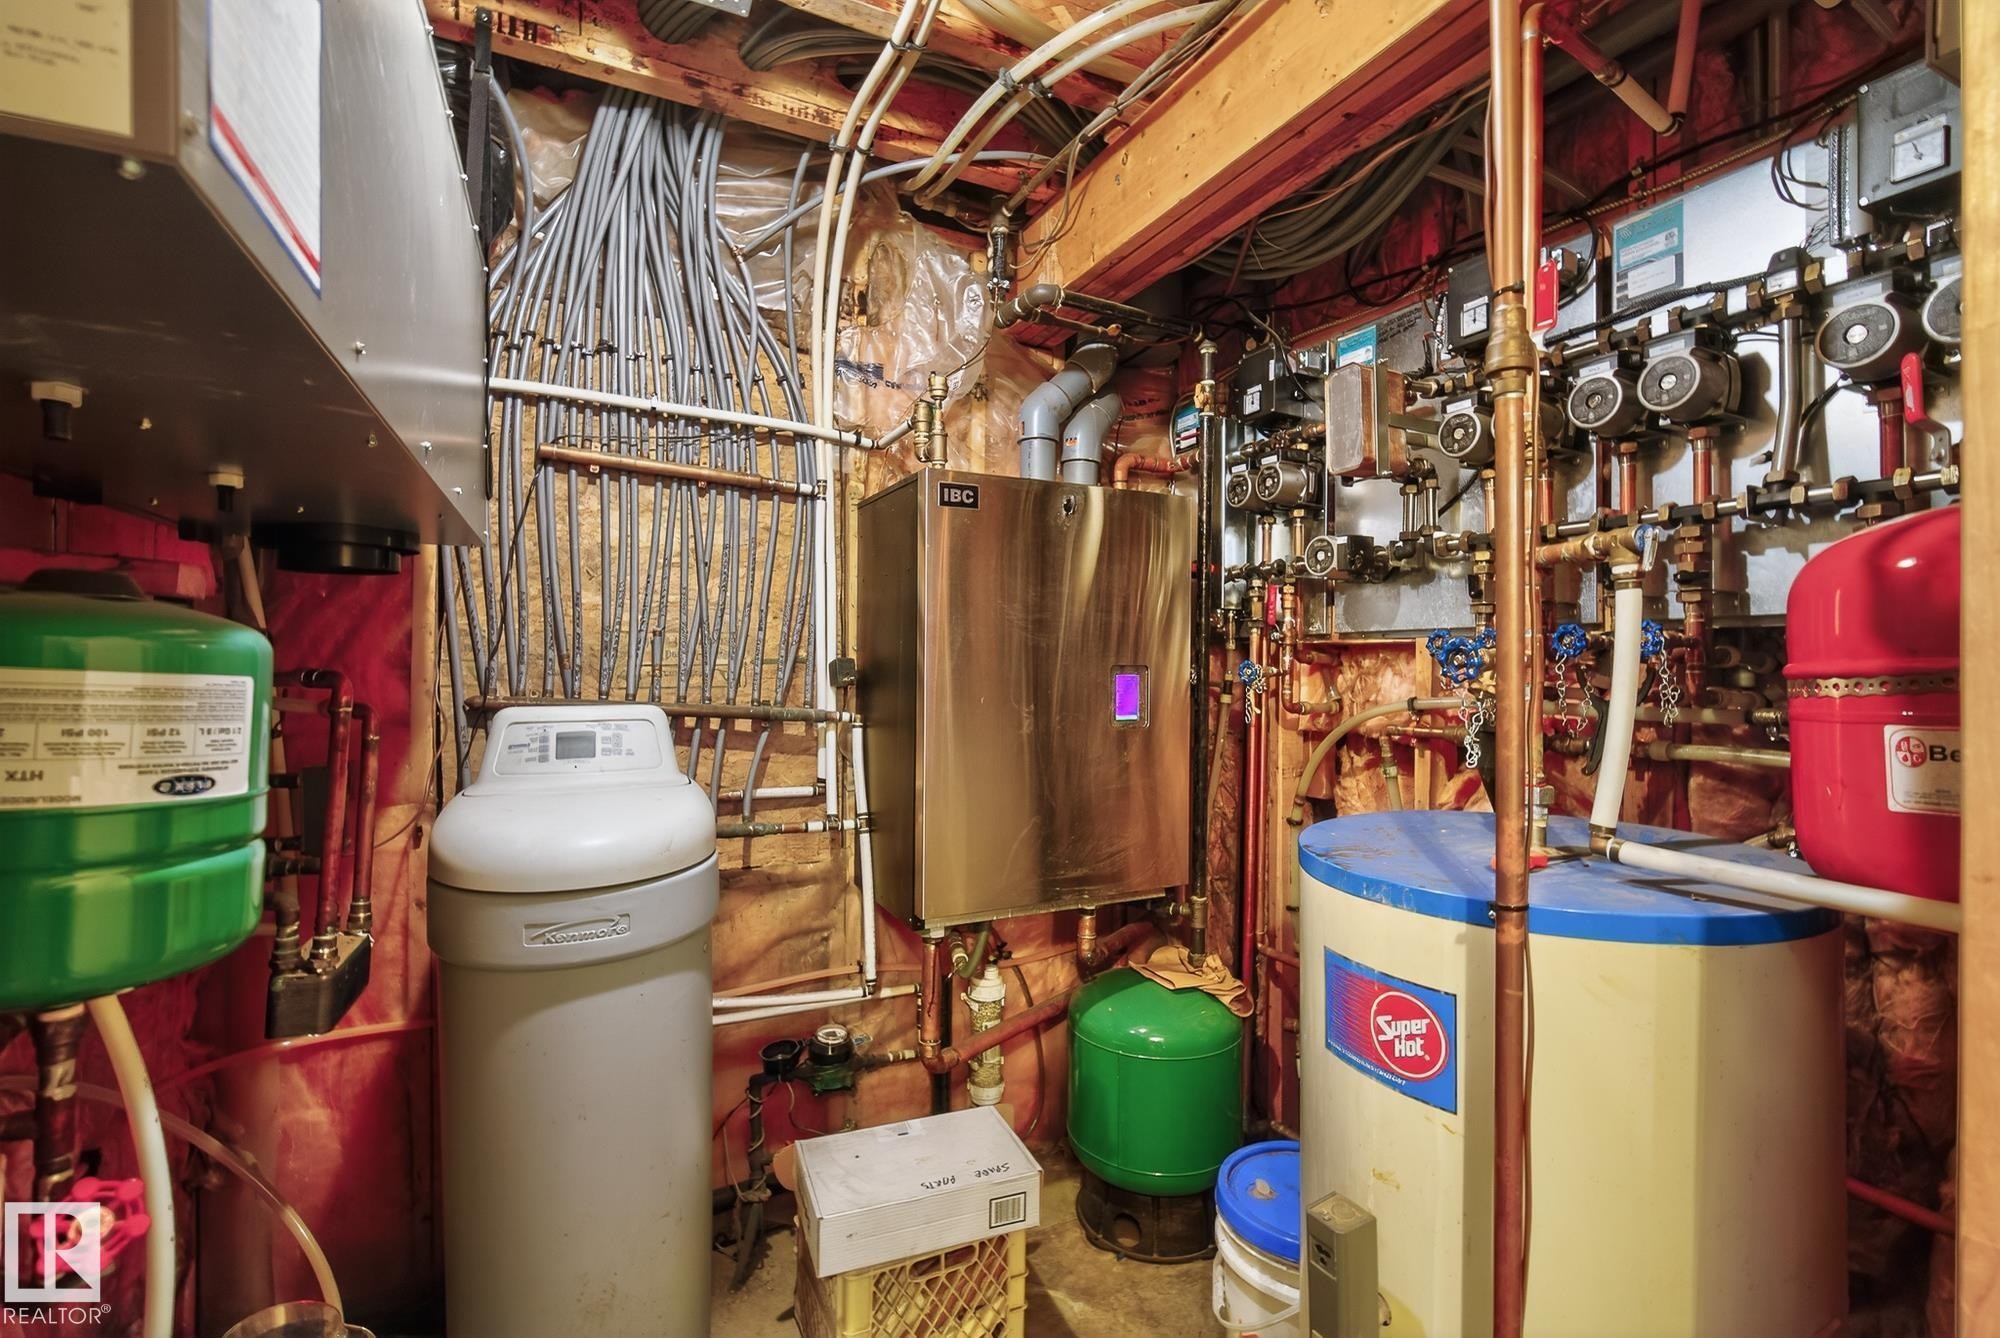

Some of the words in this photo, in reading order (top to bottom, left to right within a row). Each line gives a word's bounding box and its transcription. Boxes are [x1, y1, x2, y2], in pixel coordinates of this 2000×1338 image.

[944, 488, 975, 504] IBC
[61, 728, 84, 738] PSI
[88, 728, 109, 737] 100
[147, 728, 167, 737] PSI
[170, 728, 181, 736] 12
[4, 769, 44, 783] HTX
[543, 925, 628, 945] Kenmore
[1375, 1015, 1431, 1042] Super
[1394, 1038, 1425, 1059] Hot
[920, 1174, 957, 1190] PARTS
